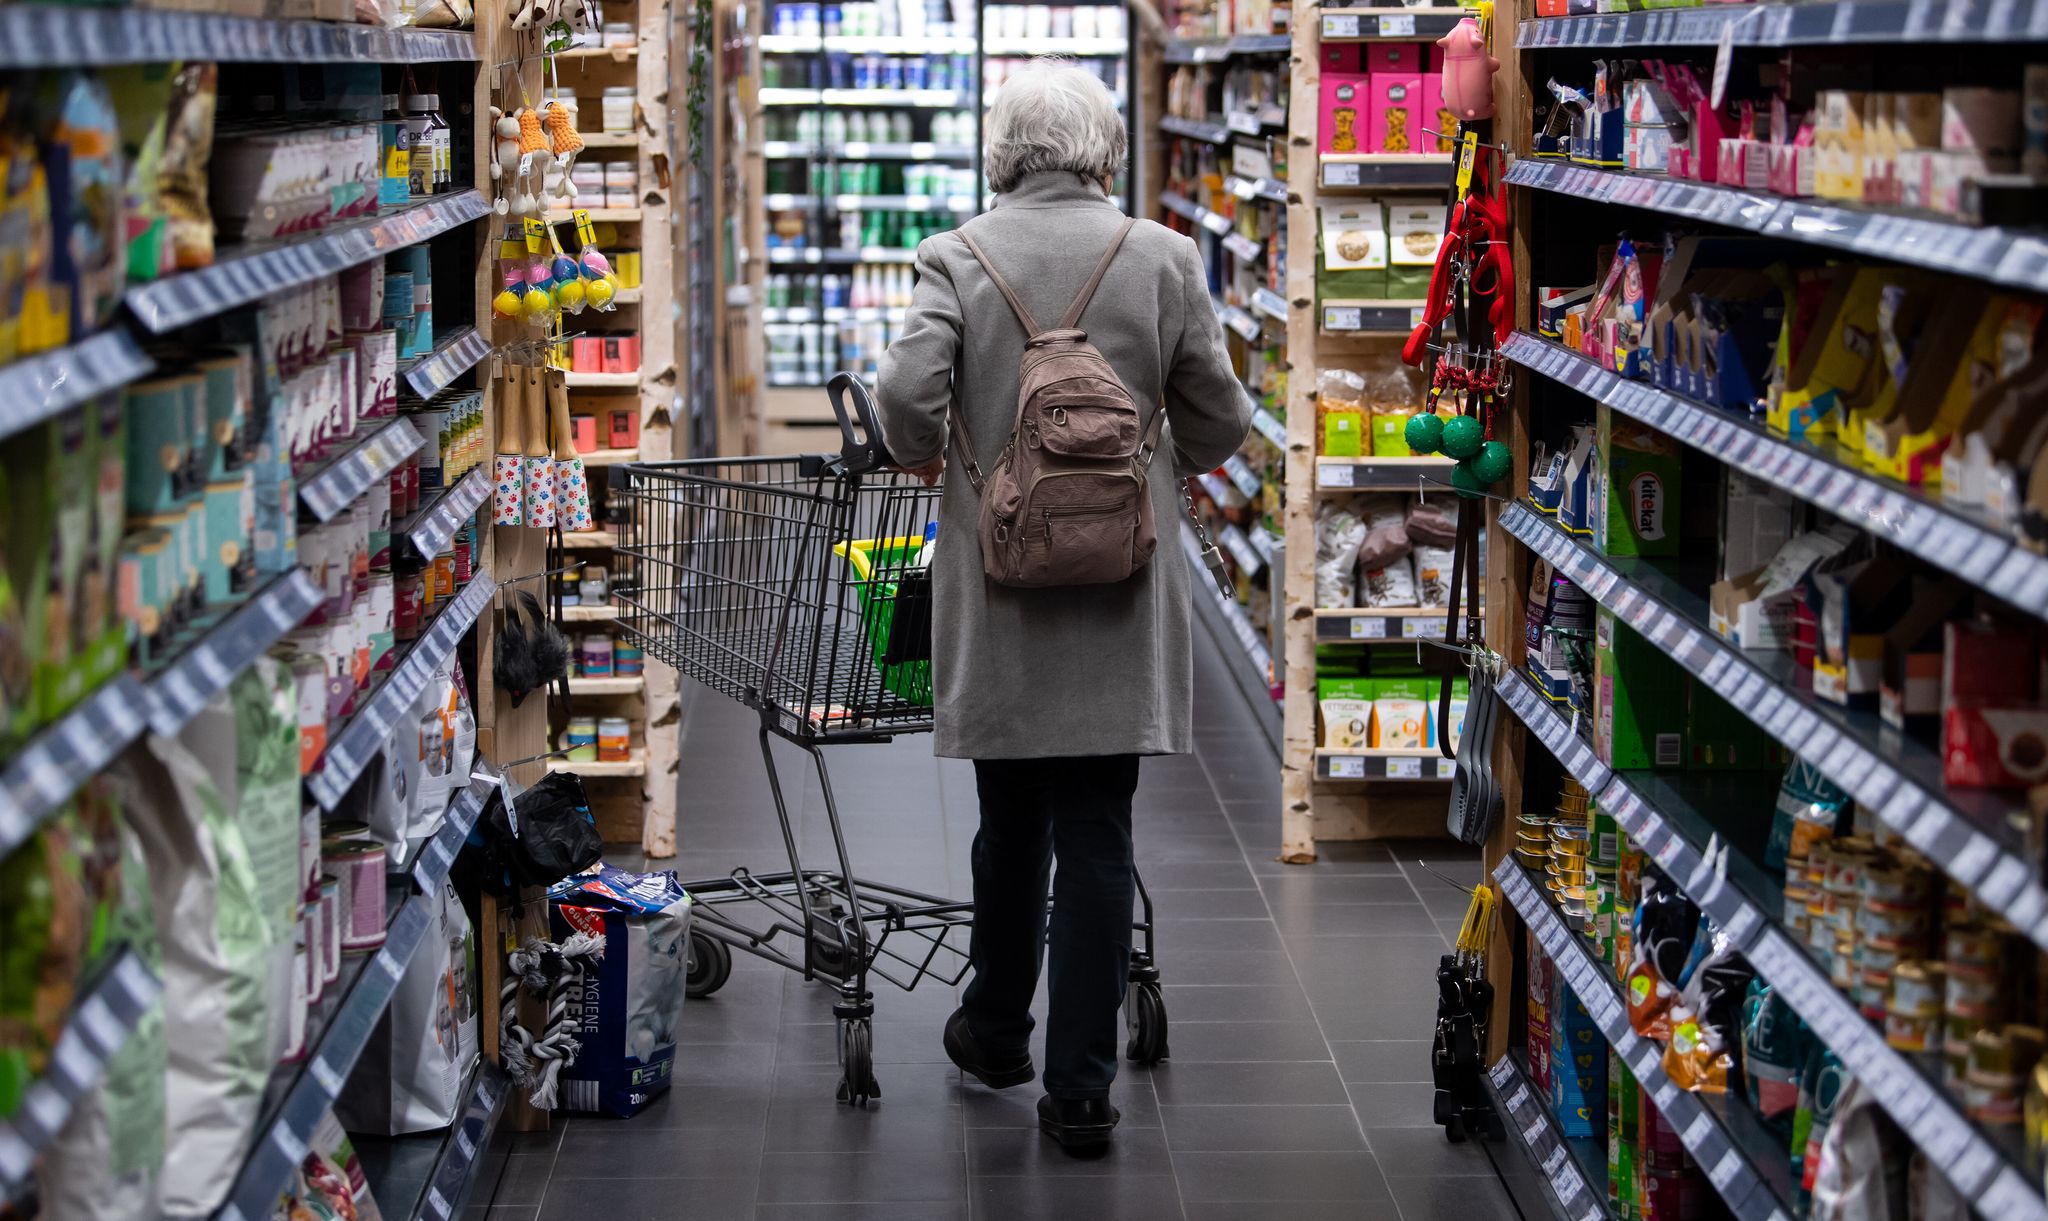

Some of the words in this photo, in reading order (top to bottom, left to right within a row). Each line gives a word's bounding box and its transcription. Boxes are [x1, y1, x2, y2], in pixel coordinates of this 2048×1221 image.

[1641, 480, 1656, 533] kitekat
[568, 907, 597, 938] GÜNSTI
[584, 973, 600, 1033] HYGIENE
[629, 1093, 640, 1105] 20
